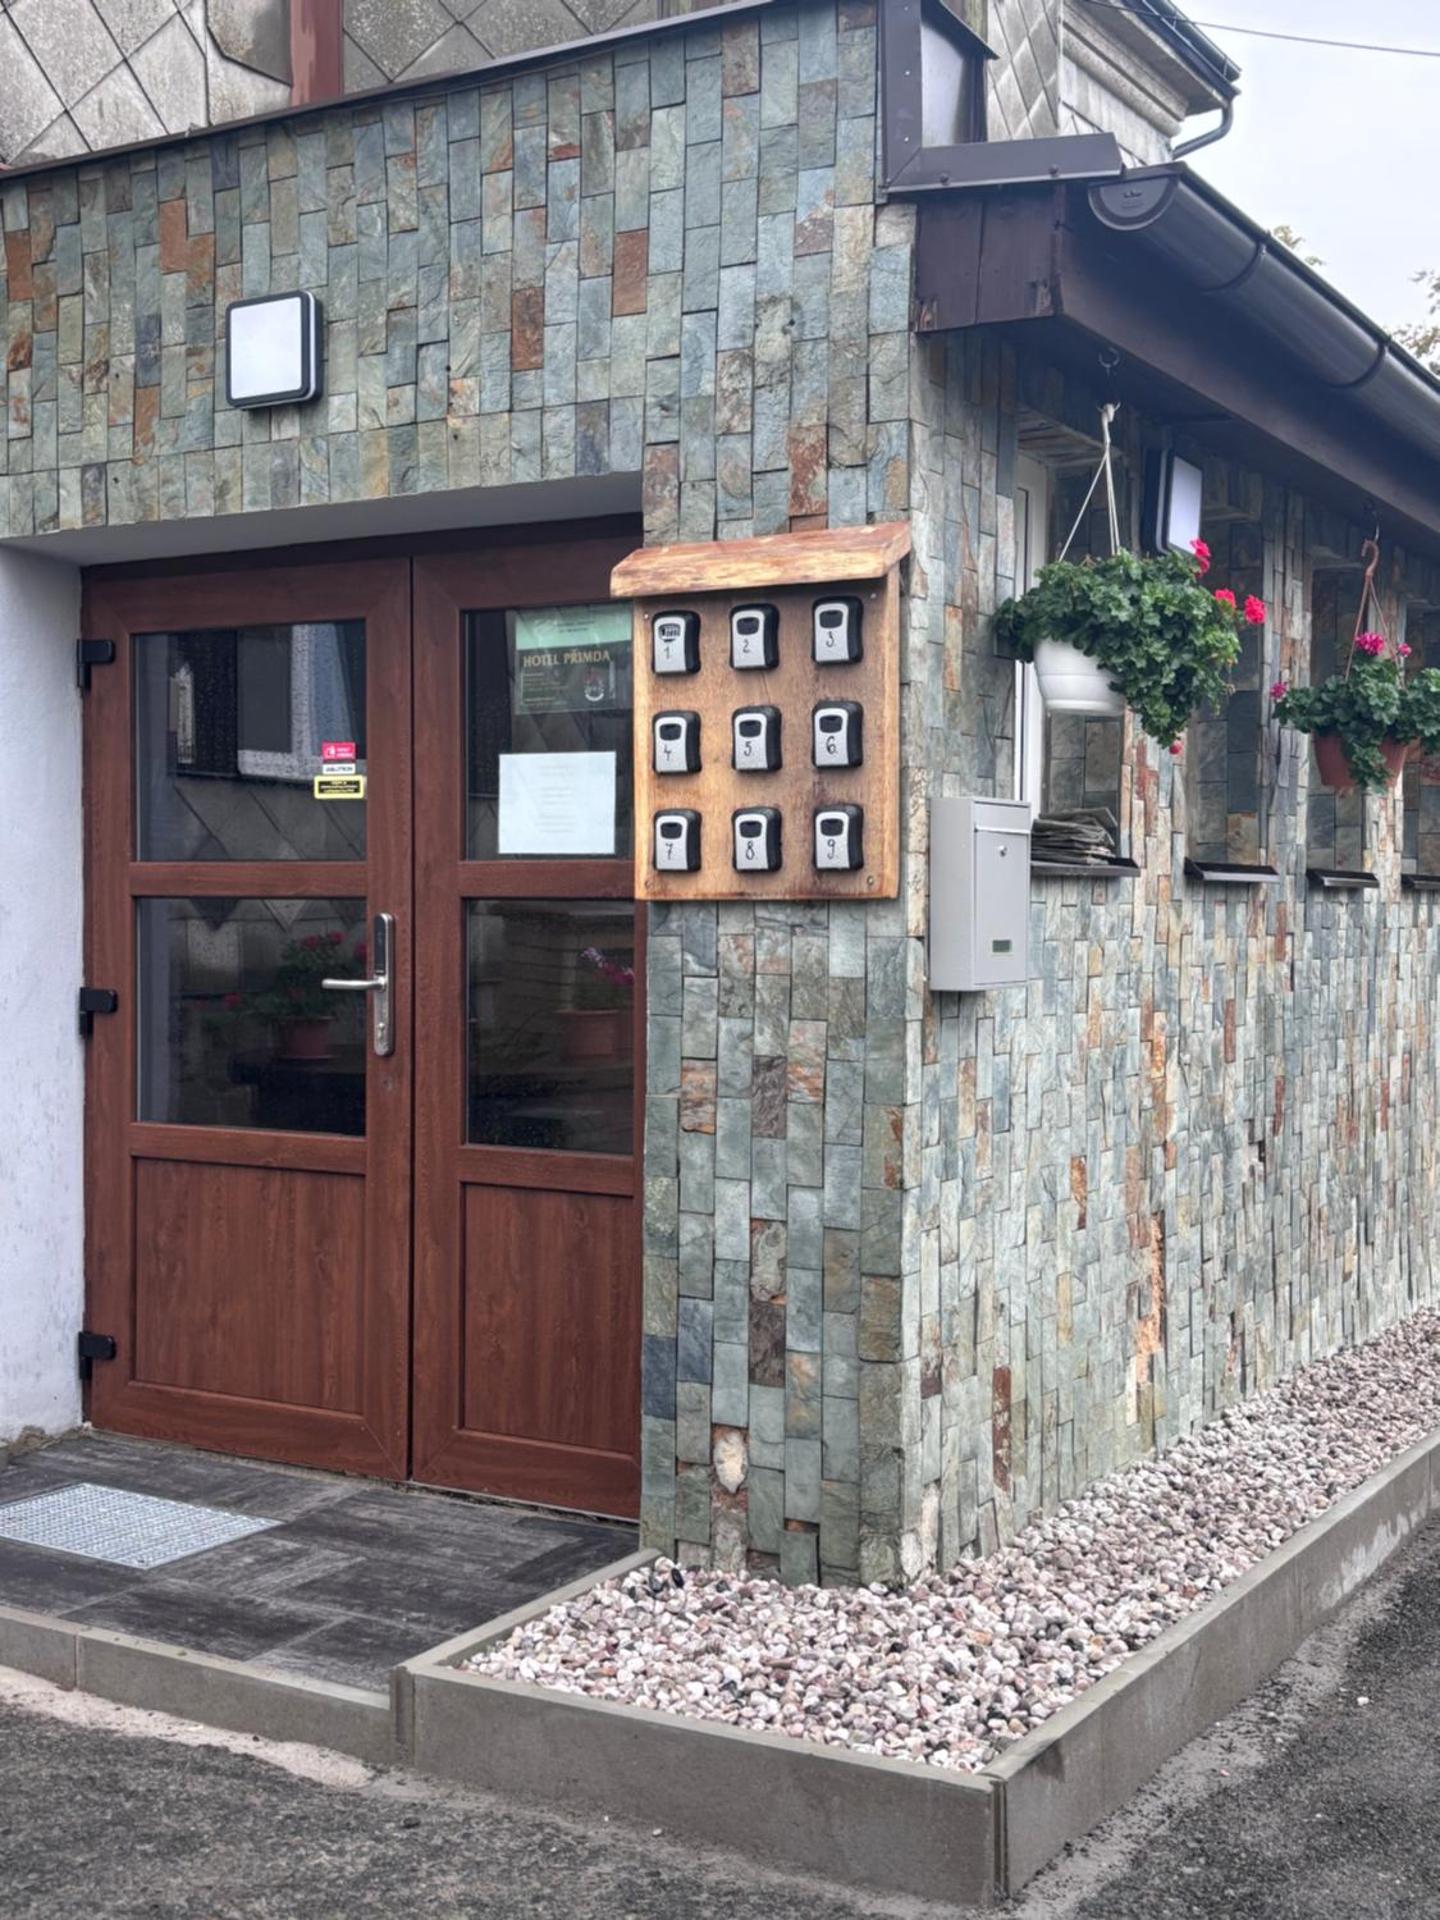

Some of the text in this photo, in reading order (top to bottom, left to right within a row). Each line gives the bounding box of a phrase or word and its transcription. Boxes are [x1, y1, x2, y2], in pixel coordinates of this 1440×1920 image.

[742, 639, 750, 653] 2
[826, 631, 834, 647] 3
[664, 646, 670, 659] 1
[664, 744, 672, 760] 4
[744, 741, 752, 756] 5
[665, 843, 673, 859] 7
[746, 841, 755, 859] 8
